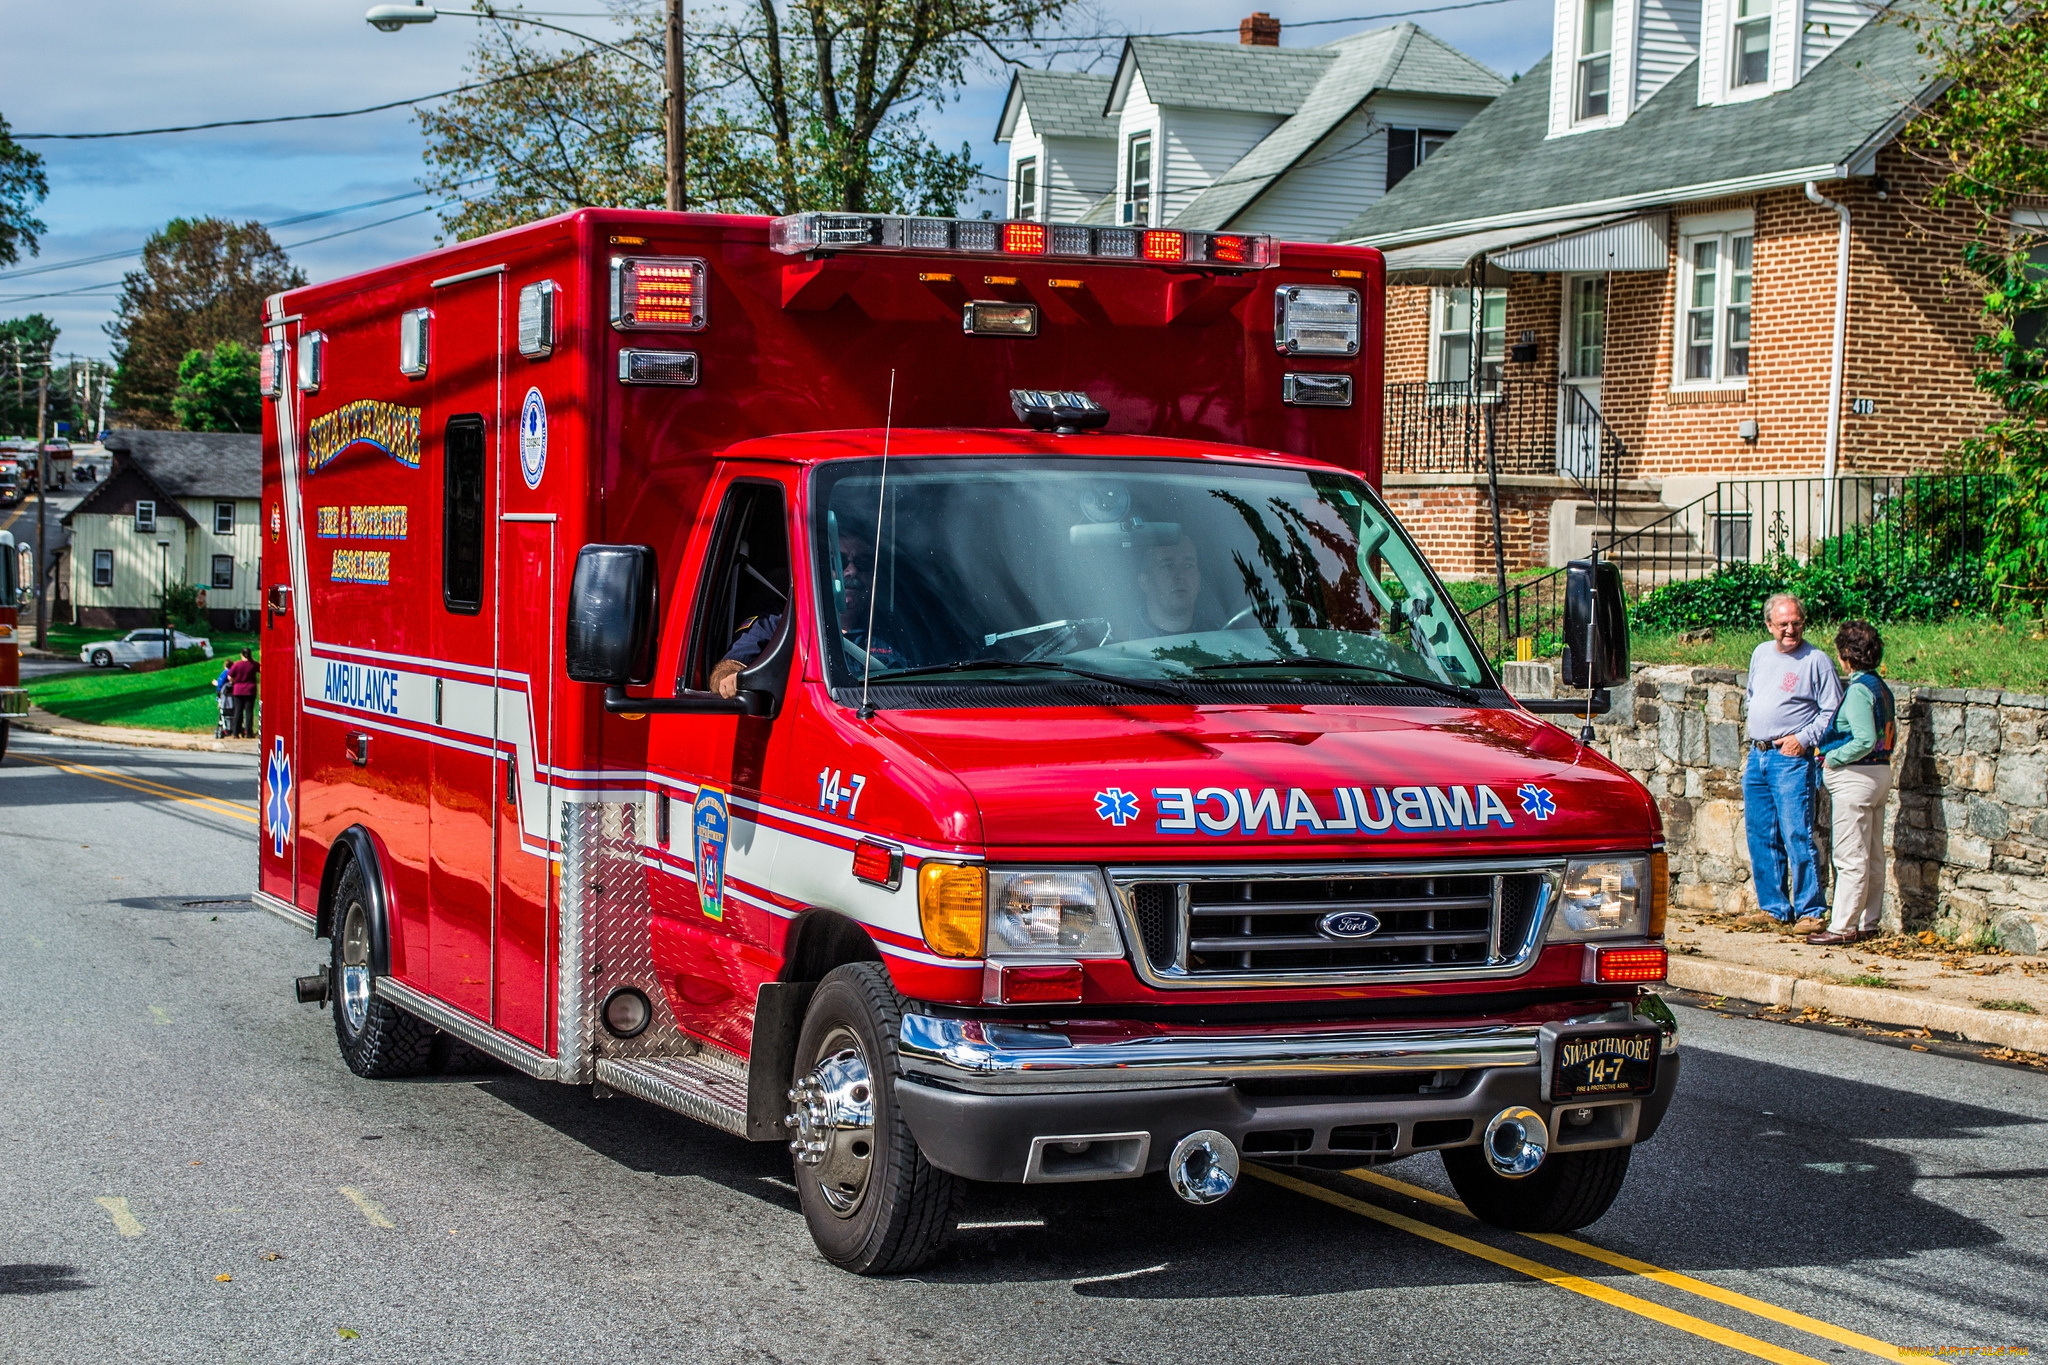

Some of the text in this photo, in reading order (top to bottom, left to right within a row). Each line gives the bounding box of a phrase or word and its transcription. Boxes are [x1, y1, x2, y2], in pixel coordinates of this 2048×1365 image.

[1852, 398, 1875, 415] 418
[308, 399, 421, 475] SWARTHMORE
[317, 506, 340, 538] FIRE
[340, 506, 348, 538] &
[349, 505, 408, 540] PROTECTIVE
[330, 549, 391, 586] ASSOCIATION
[324, 661, 399, 715] AMBULANCE
[817, 766, 867, 820] 14-7
[705, 858, 714, 882] 14
[1338, 917, 1367, 931] Ford
[1561, 1038, 1652, 1069] SWARTHMORE
[1587, 1058, 1624, 1084] 14-7
